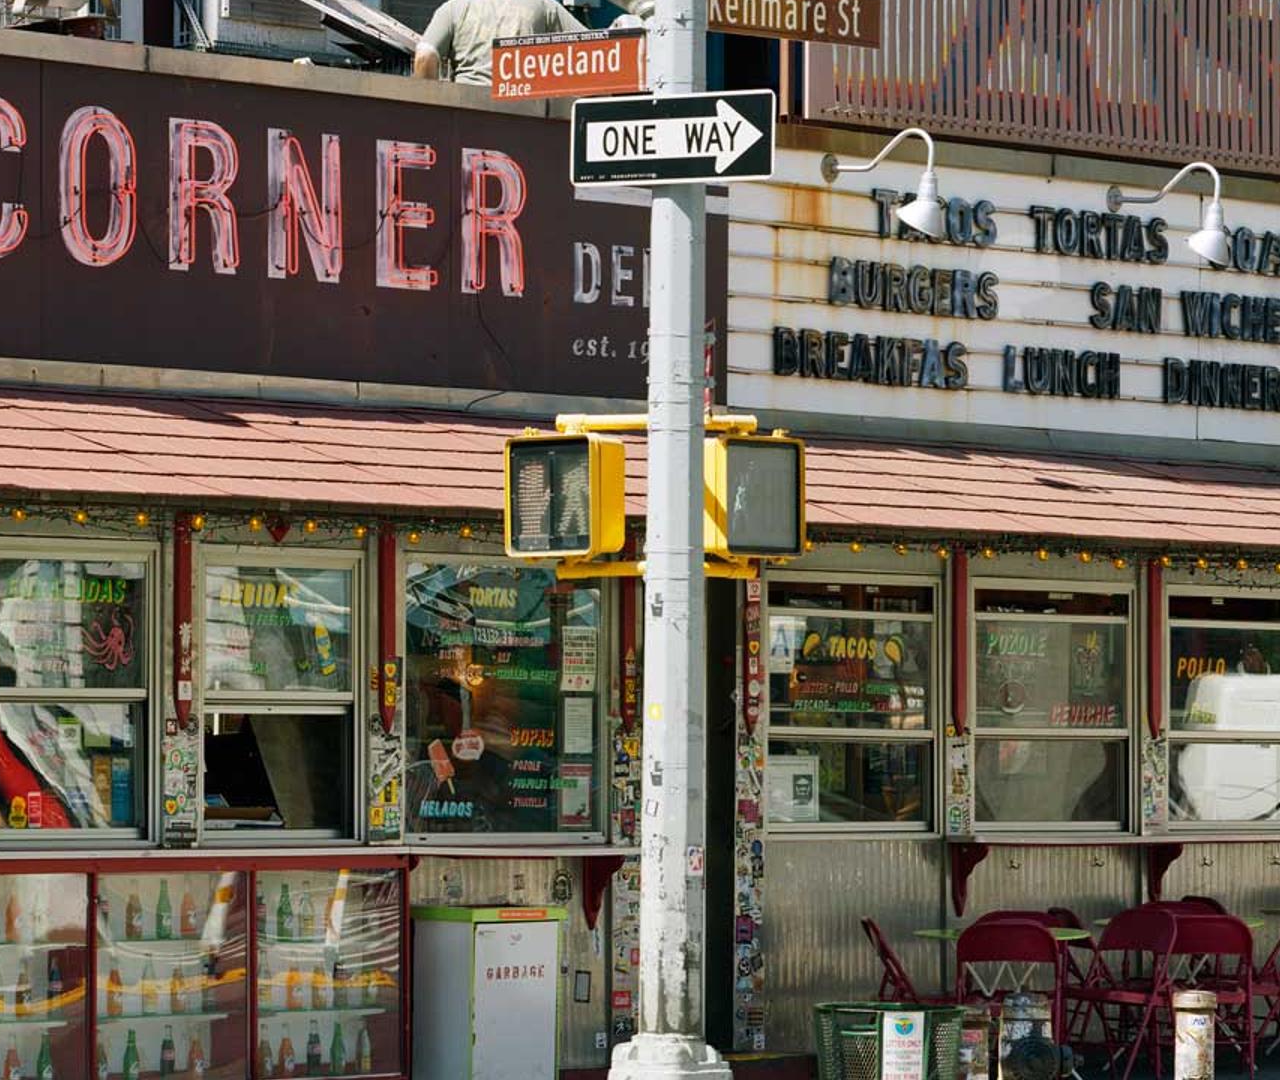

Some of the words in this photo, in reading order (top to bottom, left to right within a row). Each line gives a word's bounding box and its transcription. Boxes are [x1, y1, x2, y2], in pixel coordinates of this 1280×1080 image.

[499, 41, 620, 81] Cleveland
[498, 81, 532, 97] Place
[602, 123, 657, 157] ONE
[685, 119, 743, 154] WAY
[1030, 205, 1169, 265] TORTAS
[828, 254, 1000, 322] BURGERS
[572, 336, 617, 358] est.
[772, 324, 969, 391] BREAKFAS
[1003, 343, 1121, 399] LUNCH
[470, 586, 518, 609] TORTAS
[771, 623, 790, 657] A
[828, 635, 878, 660] TACOS
[986, 631, 1048, 658] POZOLE
[1176, 656, 1229, 681] POLLO
[1048, 702, 1119, 728] CEVICHE
[420, 800, 473, 819] HELADOS
[486, 964, 545, 981] GARBAGE
